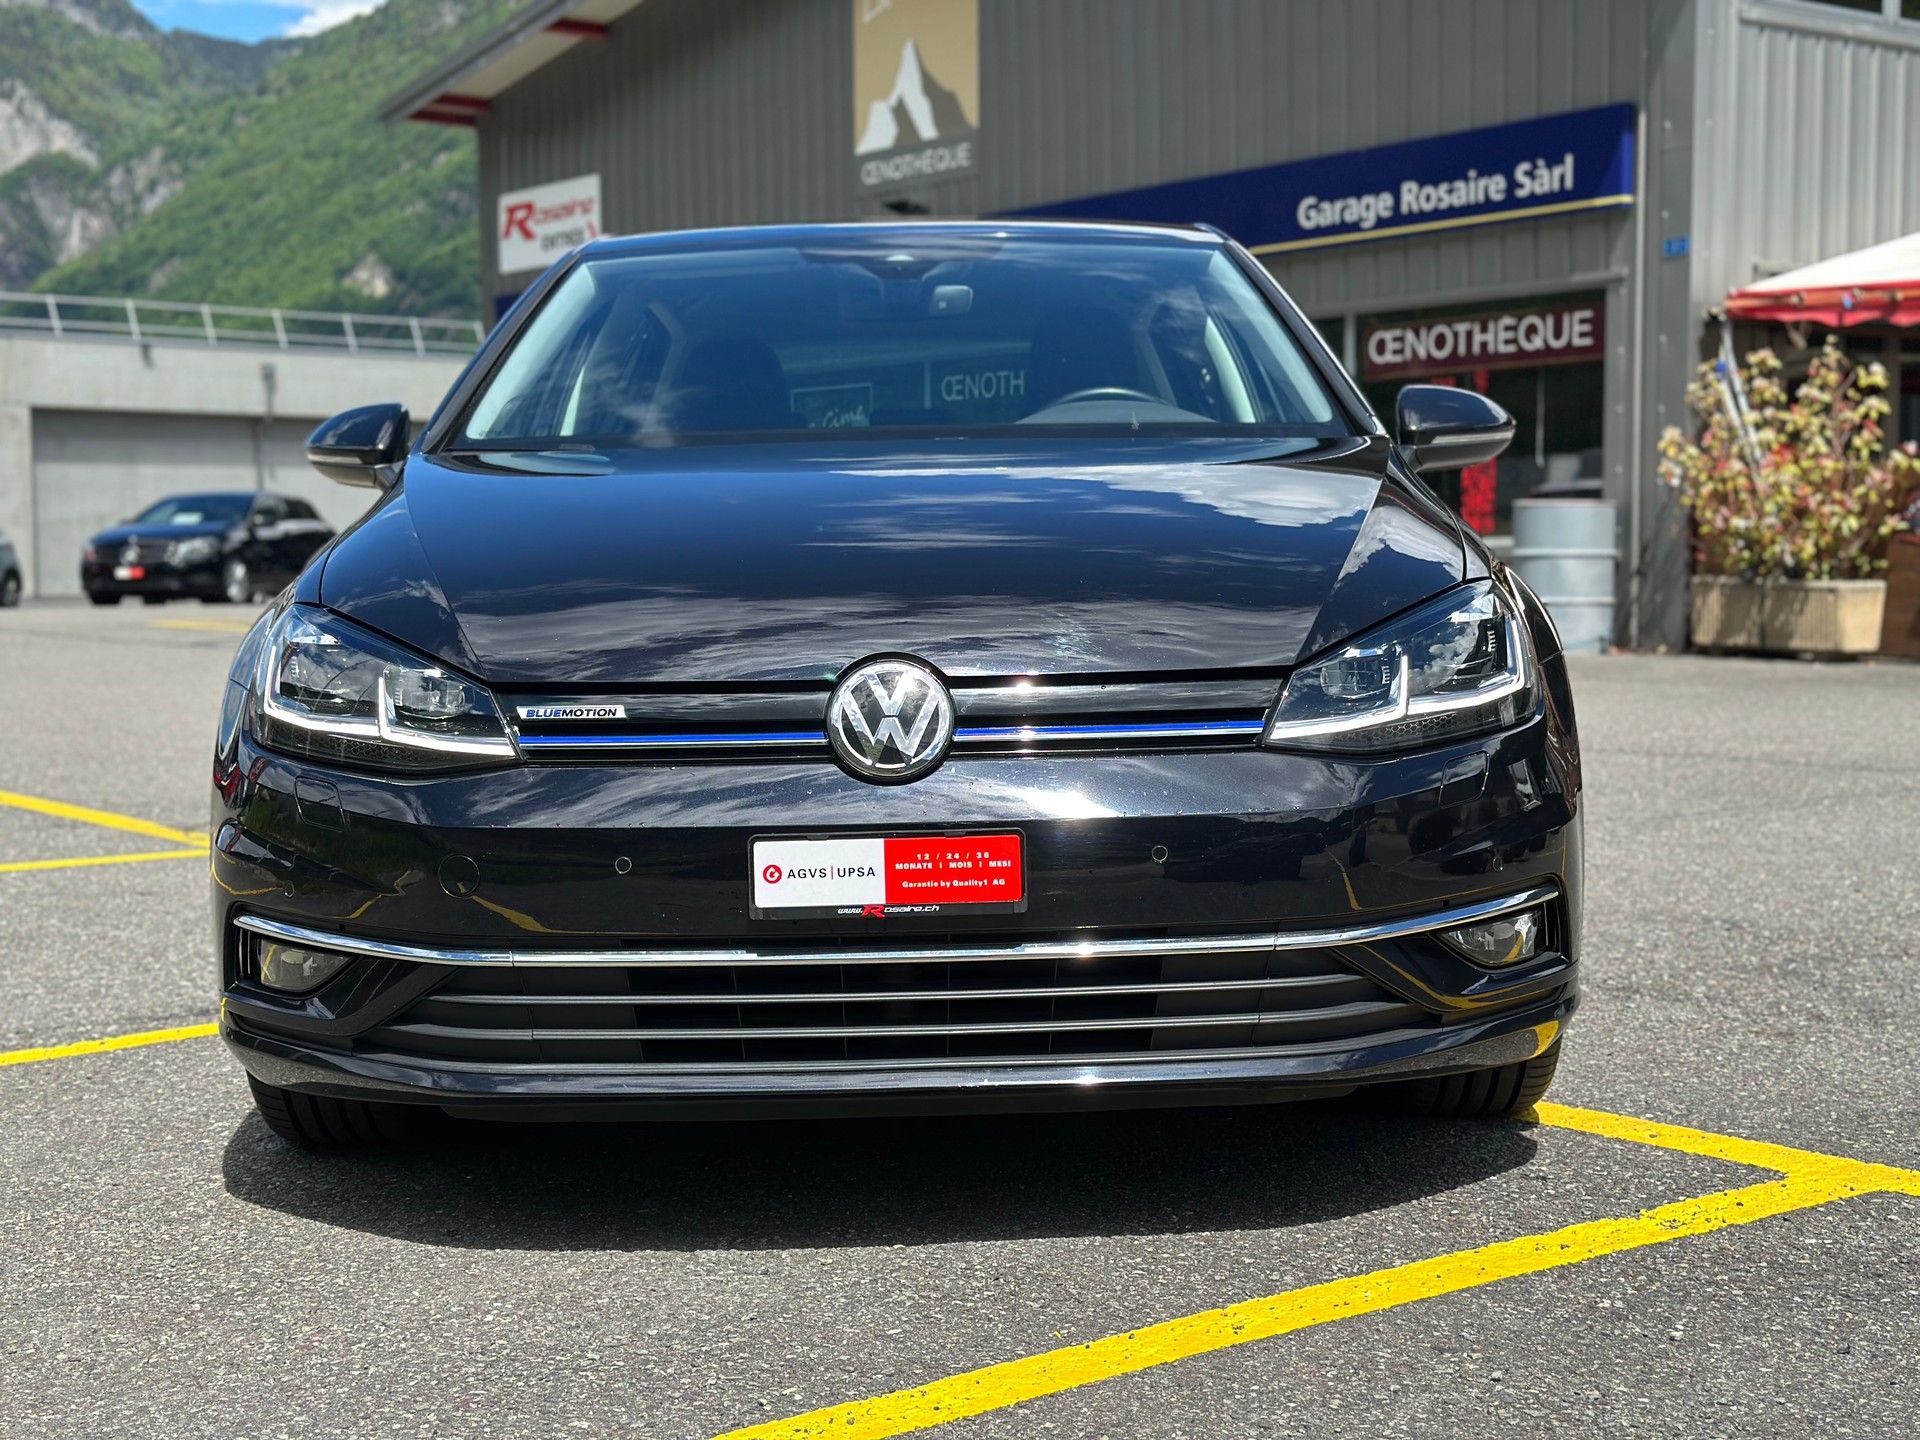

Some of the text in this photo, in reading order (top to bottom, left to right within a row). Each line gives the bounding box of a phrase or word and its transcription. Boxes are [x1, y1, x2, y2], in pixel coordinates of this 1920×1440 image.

[1296, 152, 1575, 230] Garage Rosaire Sàrl
[526, 708, 617, 718] BLUEMOTION
[916, 853, 930, 861] 12
[946, 852, 960, 860] 24
[976, 852, 990, 860] 36
[895, 862, 933, 870] MONATE
[949, 861, 973, 869] MOIS
[989, 860, 1011, 868] MESI
[787, 866, 876, 879] AGVS UPSA
[902, 880, 939, 888] Garantie
[940, 880, 951, 888] by
[992, 878, 1005, 886] AG
